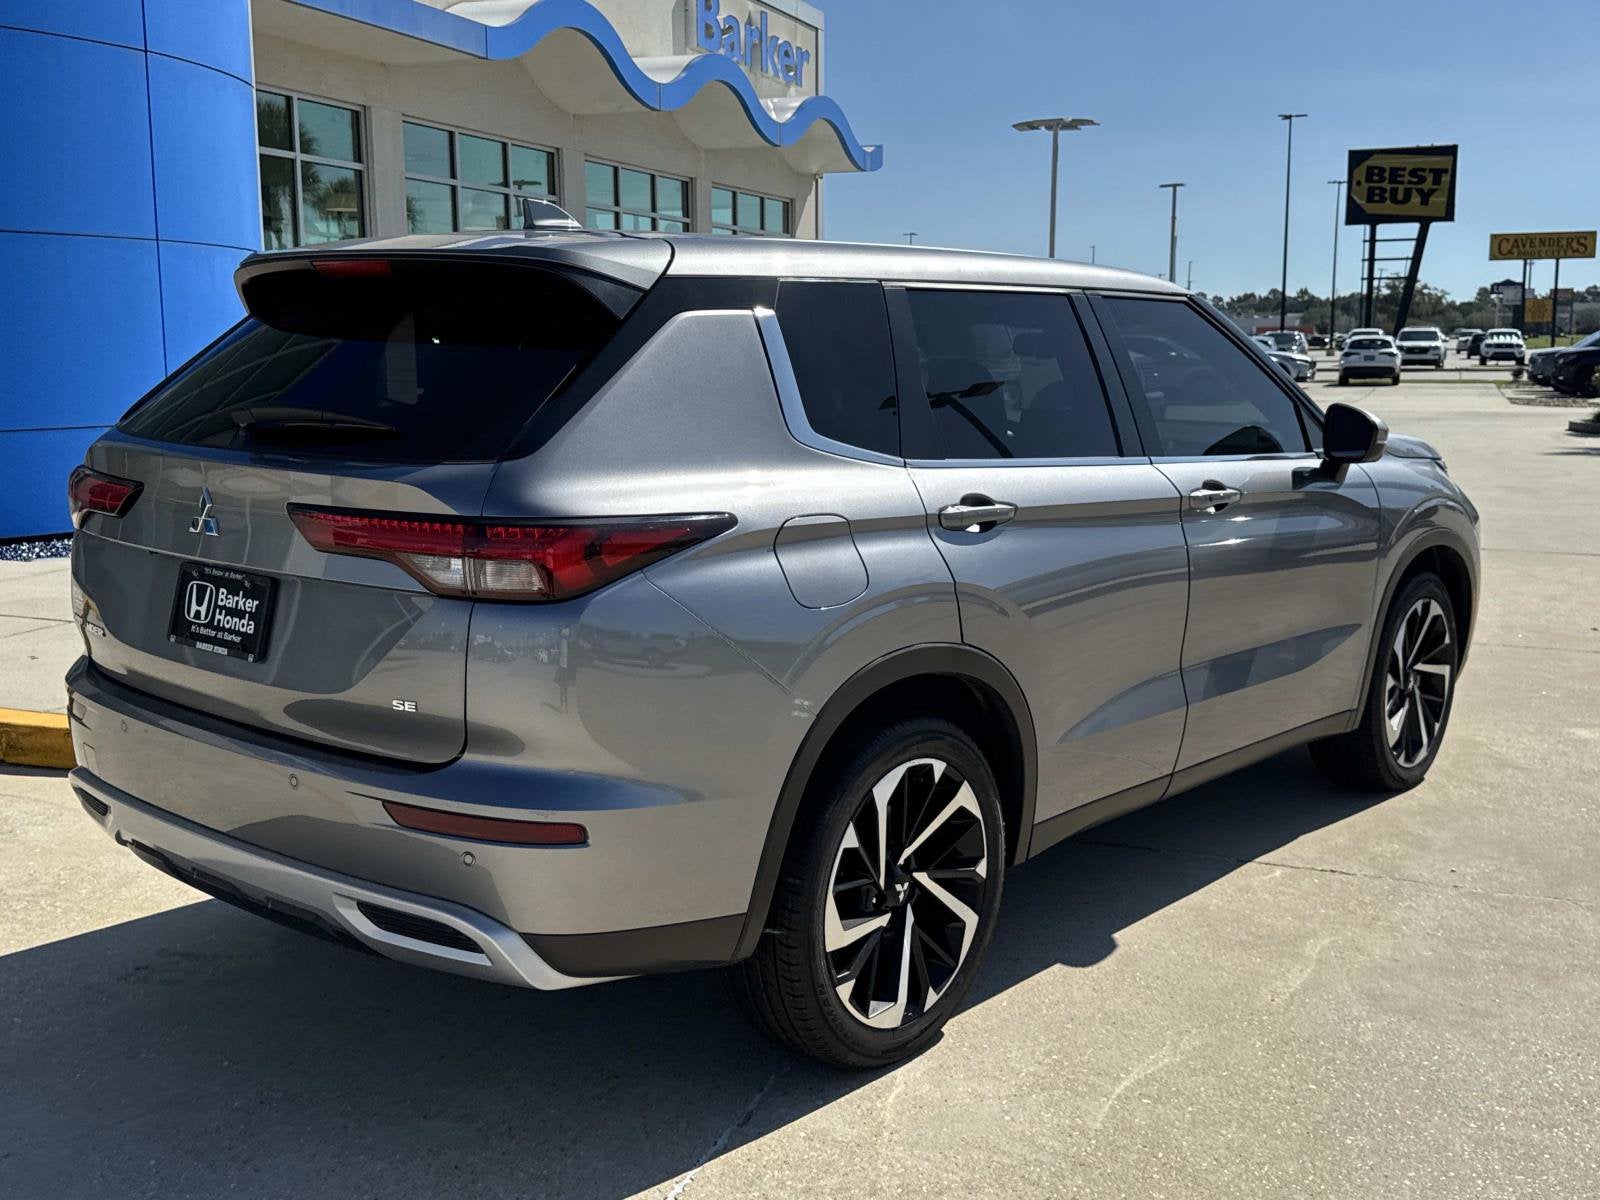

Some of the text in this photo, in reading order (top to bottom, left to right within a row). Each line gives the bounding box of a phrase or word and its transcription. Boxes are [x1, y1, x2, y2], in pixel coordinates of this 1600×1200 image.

[696, 0, 810, 88] Barker
[1365, 165, 1449, 186] BEST
[1366, 185, 1440, 206] BUY
[218, 587, 259, 613] Barker
[214, 608, 255, 634] Honda
[392, 699, 416, 712] SE
